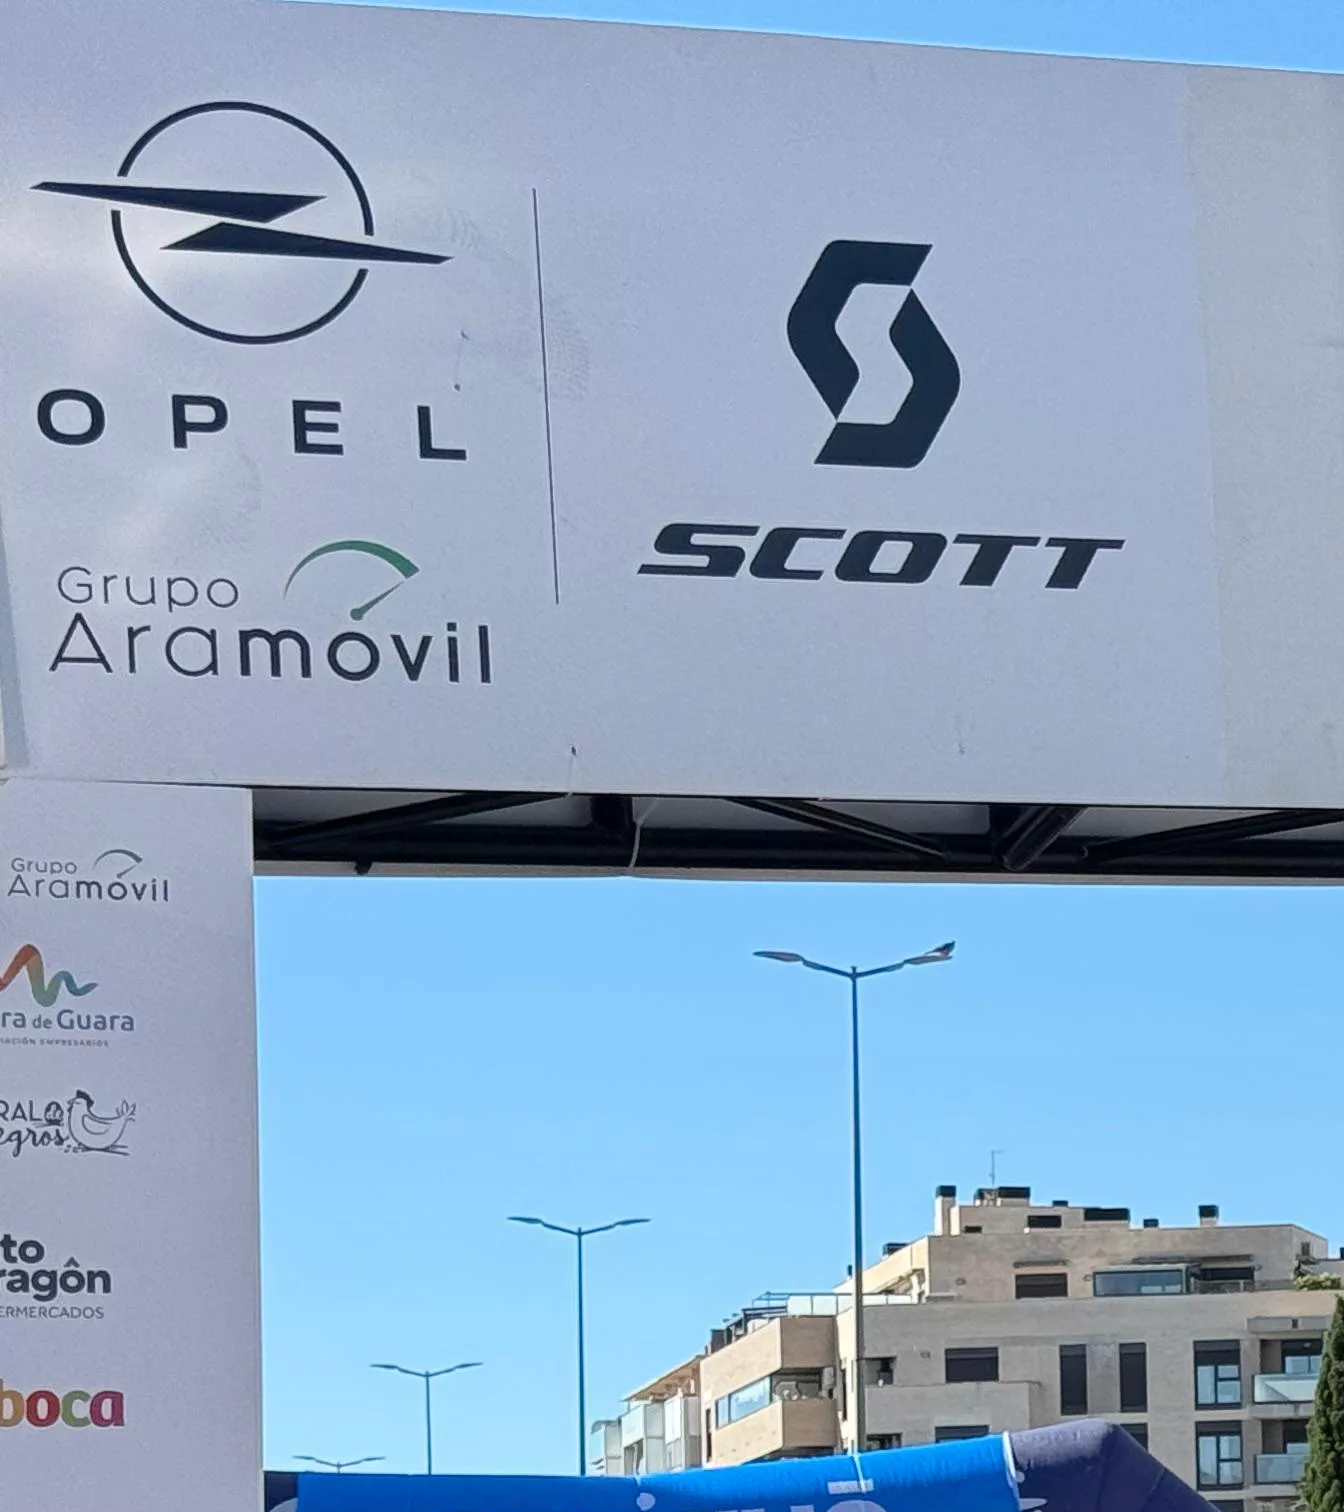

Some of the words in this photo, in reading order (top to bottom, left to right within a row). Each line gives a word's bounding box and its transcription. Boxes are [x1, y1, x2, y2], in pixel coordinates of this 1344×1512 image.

[36, 388, 468, 461] OPEL
[637, 522, 1125, 590] SCOTT
[57, 566, 240, 610] Grupo
[49, 613, 494, 685] Aramóvil
[11, 857, 78, 875] Grupo
[32, 1013, 53, 1030] de
[57, 1009, 136, 1032] Guara
